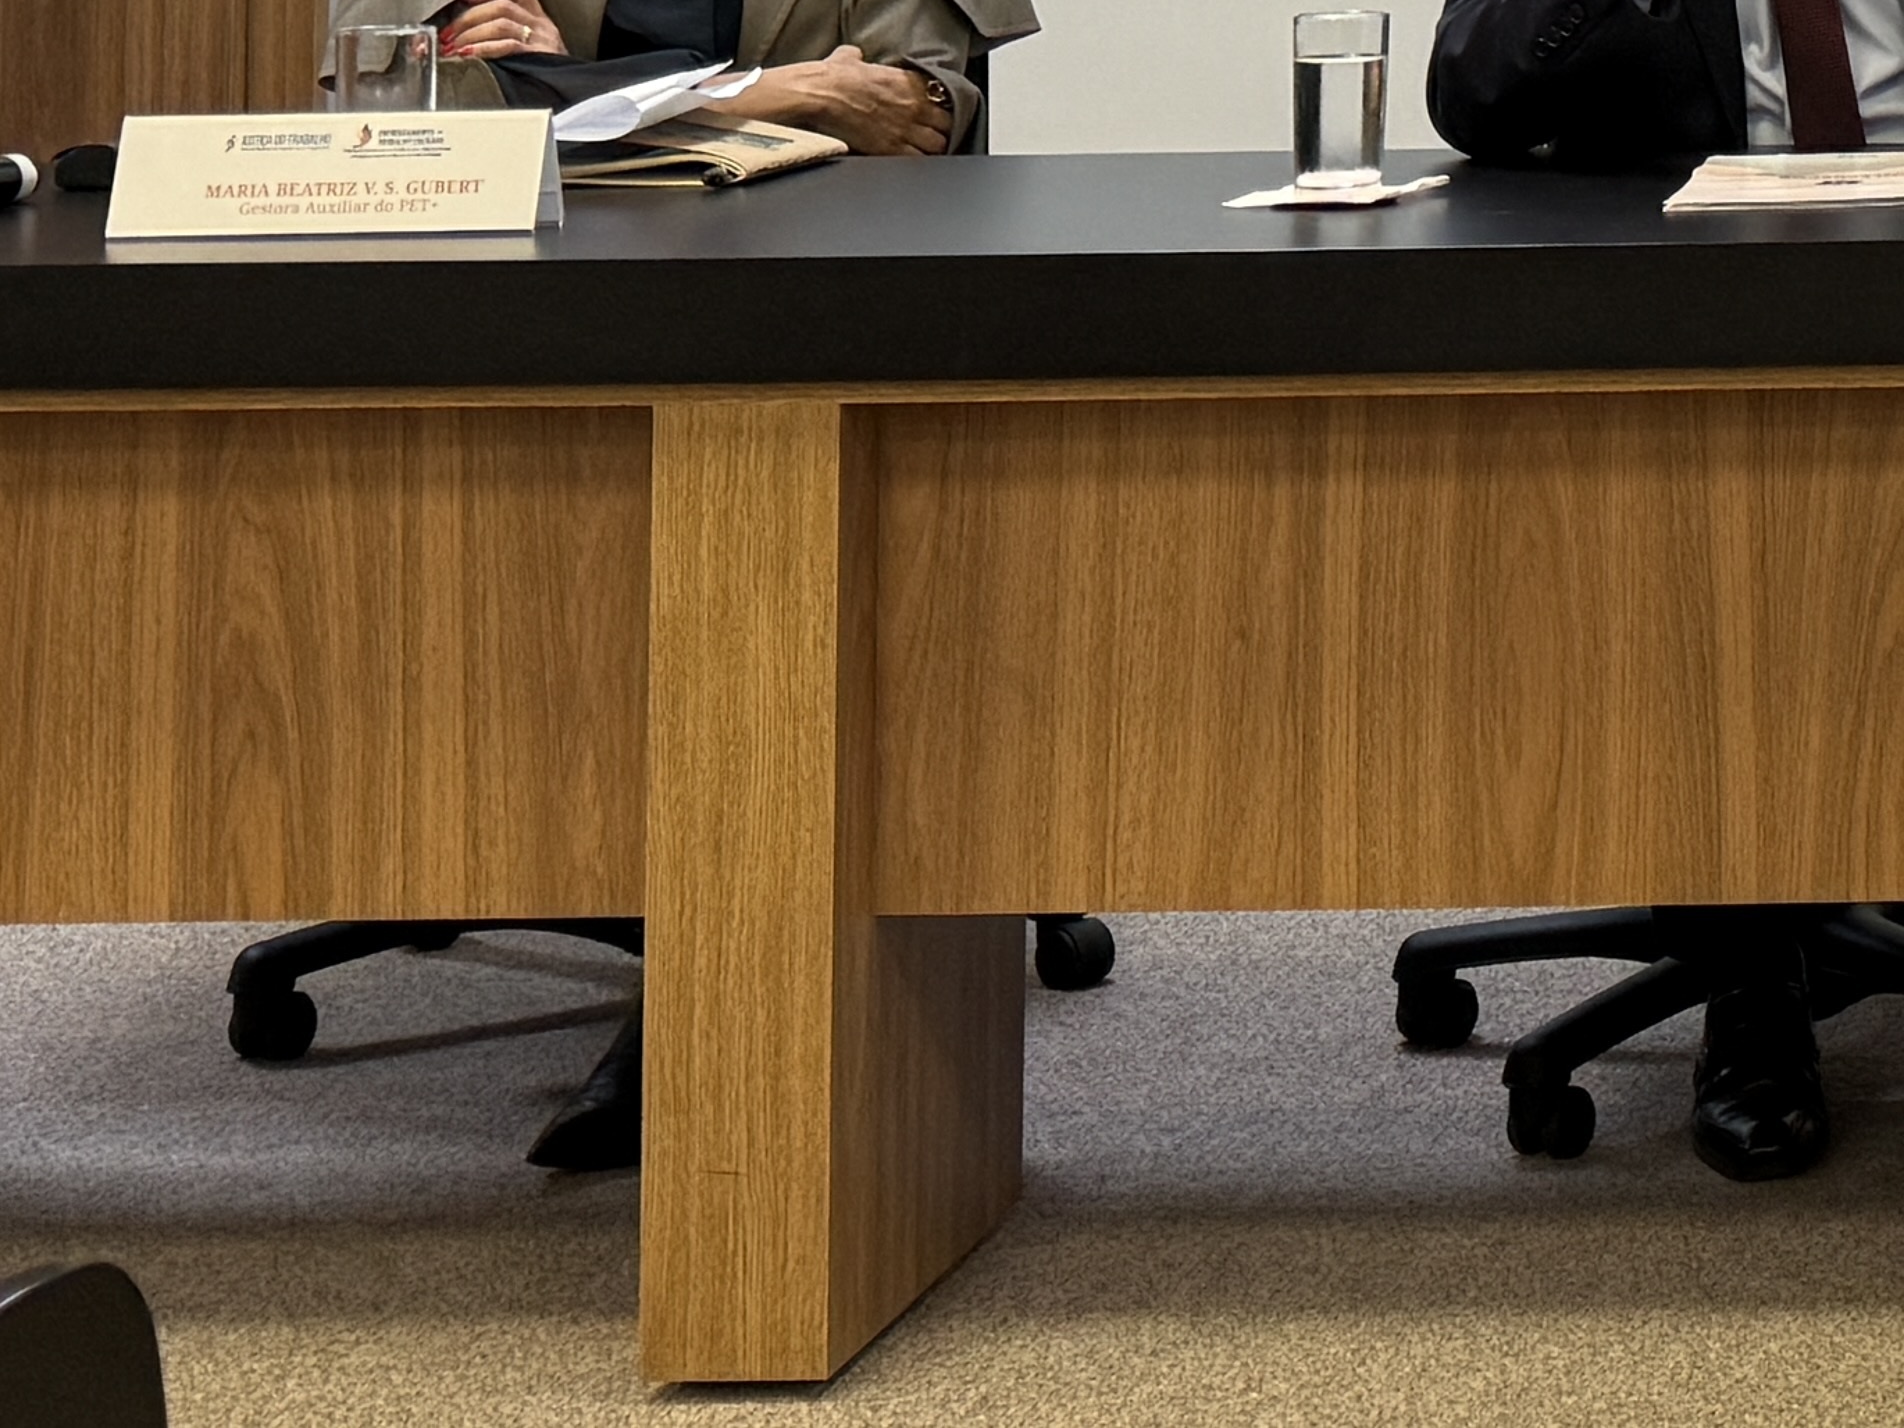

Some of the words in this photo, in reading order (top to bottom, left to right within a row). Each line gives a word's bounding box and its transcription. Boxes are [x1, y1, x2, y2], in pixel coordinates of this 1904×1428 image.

[205, 182, 270, 199] MARIA
[276, 181, 358, 198] BEATRIZ
[364, 180, 378, 197] V.
[384, 180, 400, 196] S.
[405, 179, 486, 196] GUBERT
[239, 200, 300, 216] Gestora
[305, 200, 371, 215] Auxiliar
[374, 199, 394, 213] do
